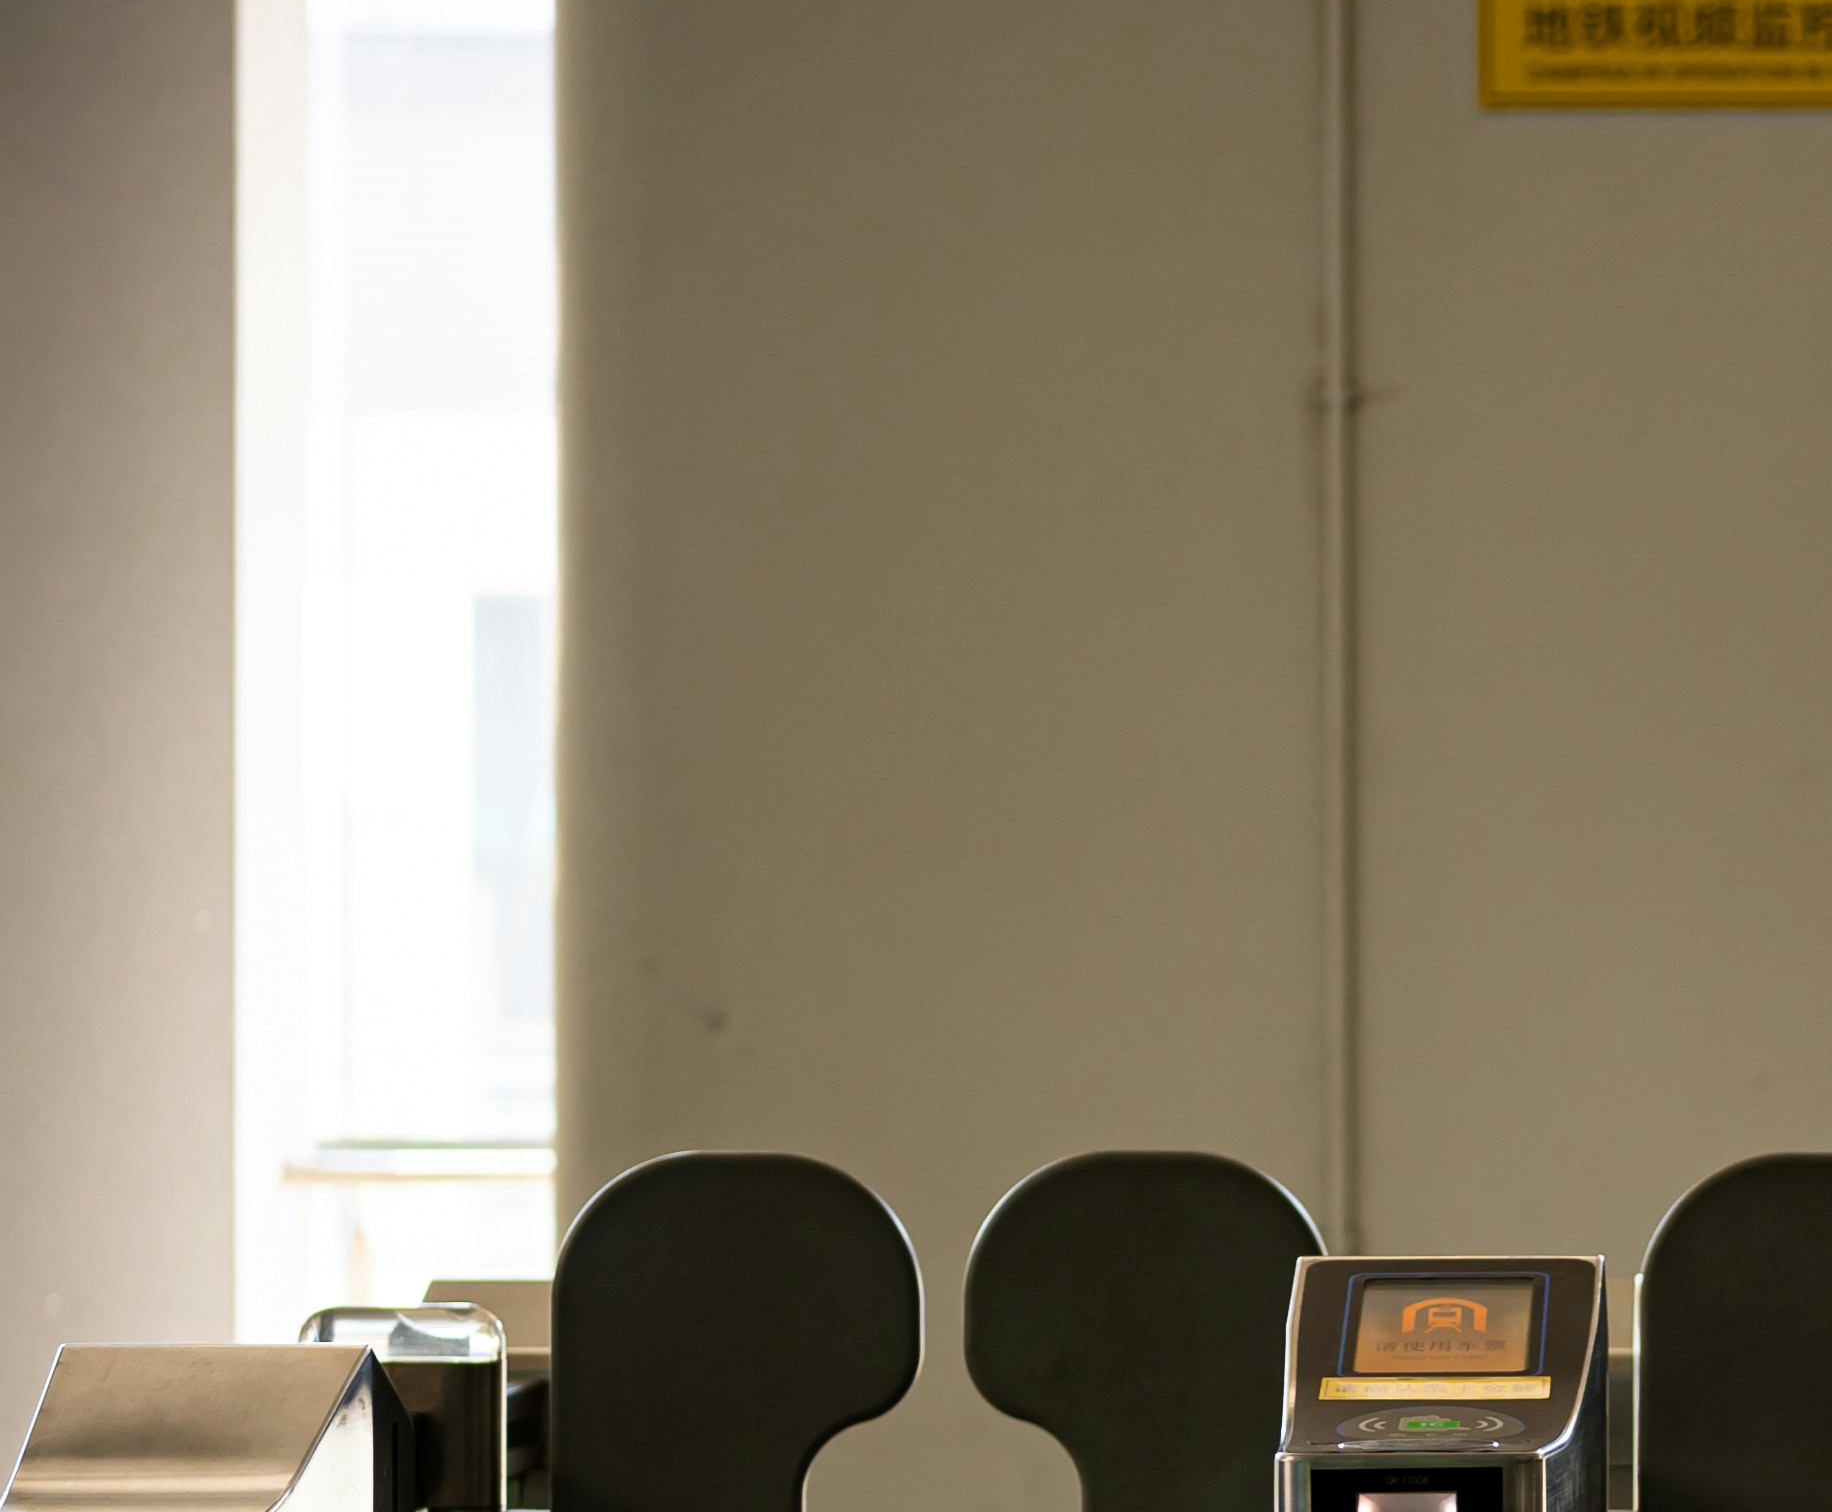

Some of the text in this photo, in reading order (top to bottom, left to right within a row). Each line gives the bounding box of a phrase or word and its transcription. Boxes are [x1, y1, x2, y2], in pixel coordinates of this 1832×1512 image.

[1376, 1339, 1507, 1352] 请使用车票
